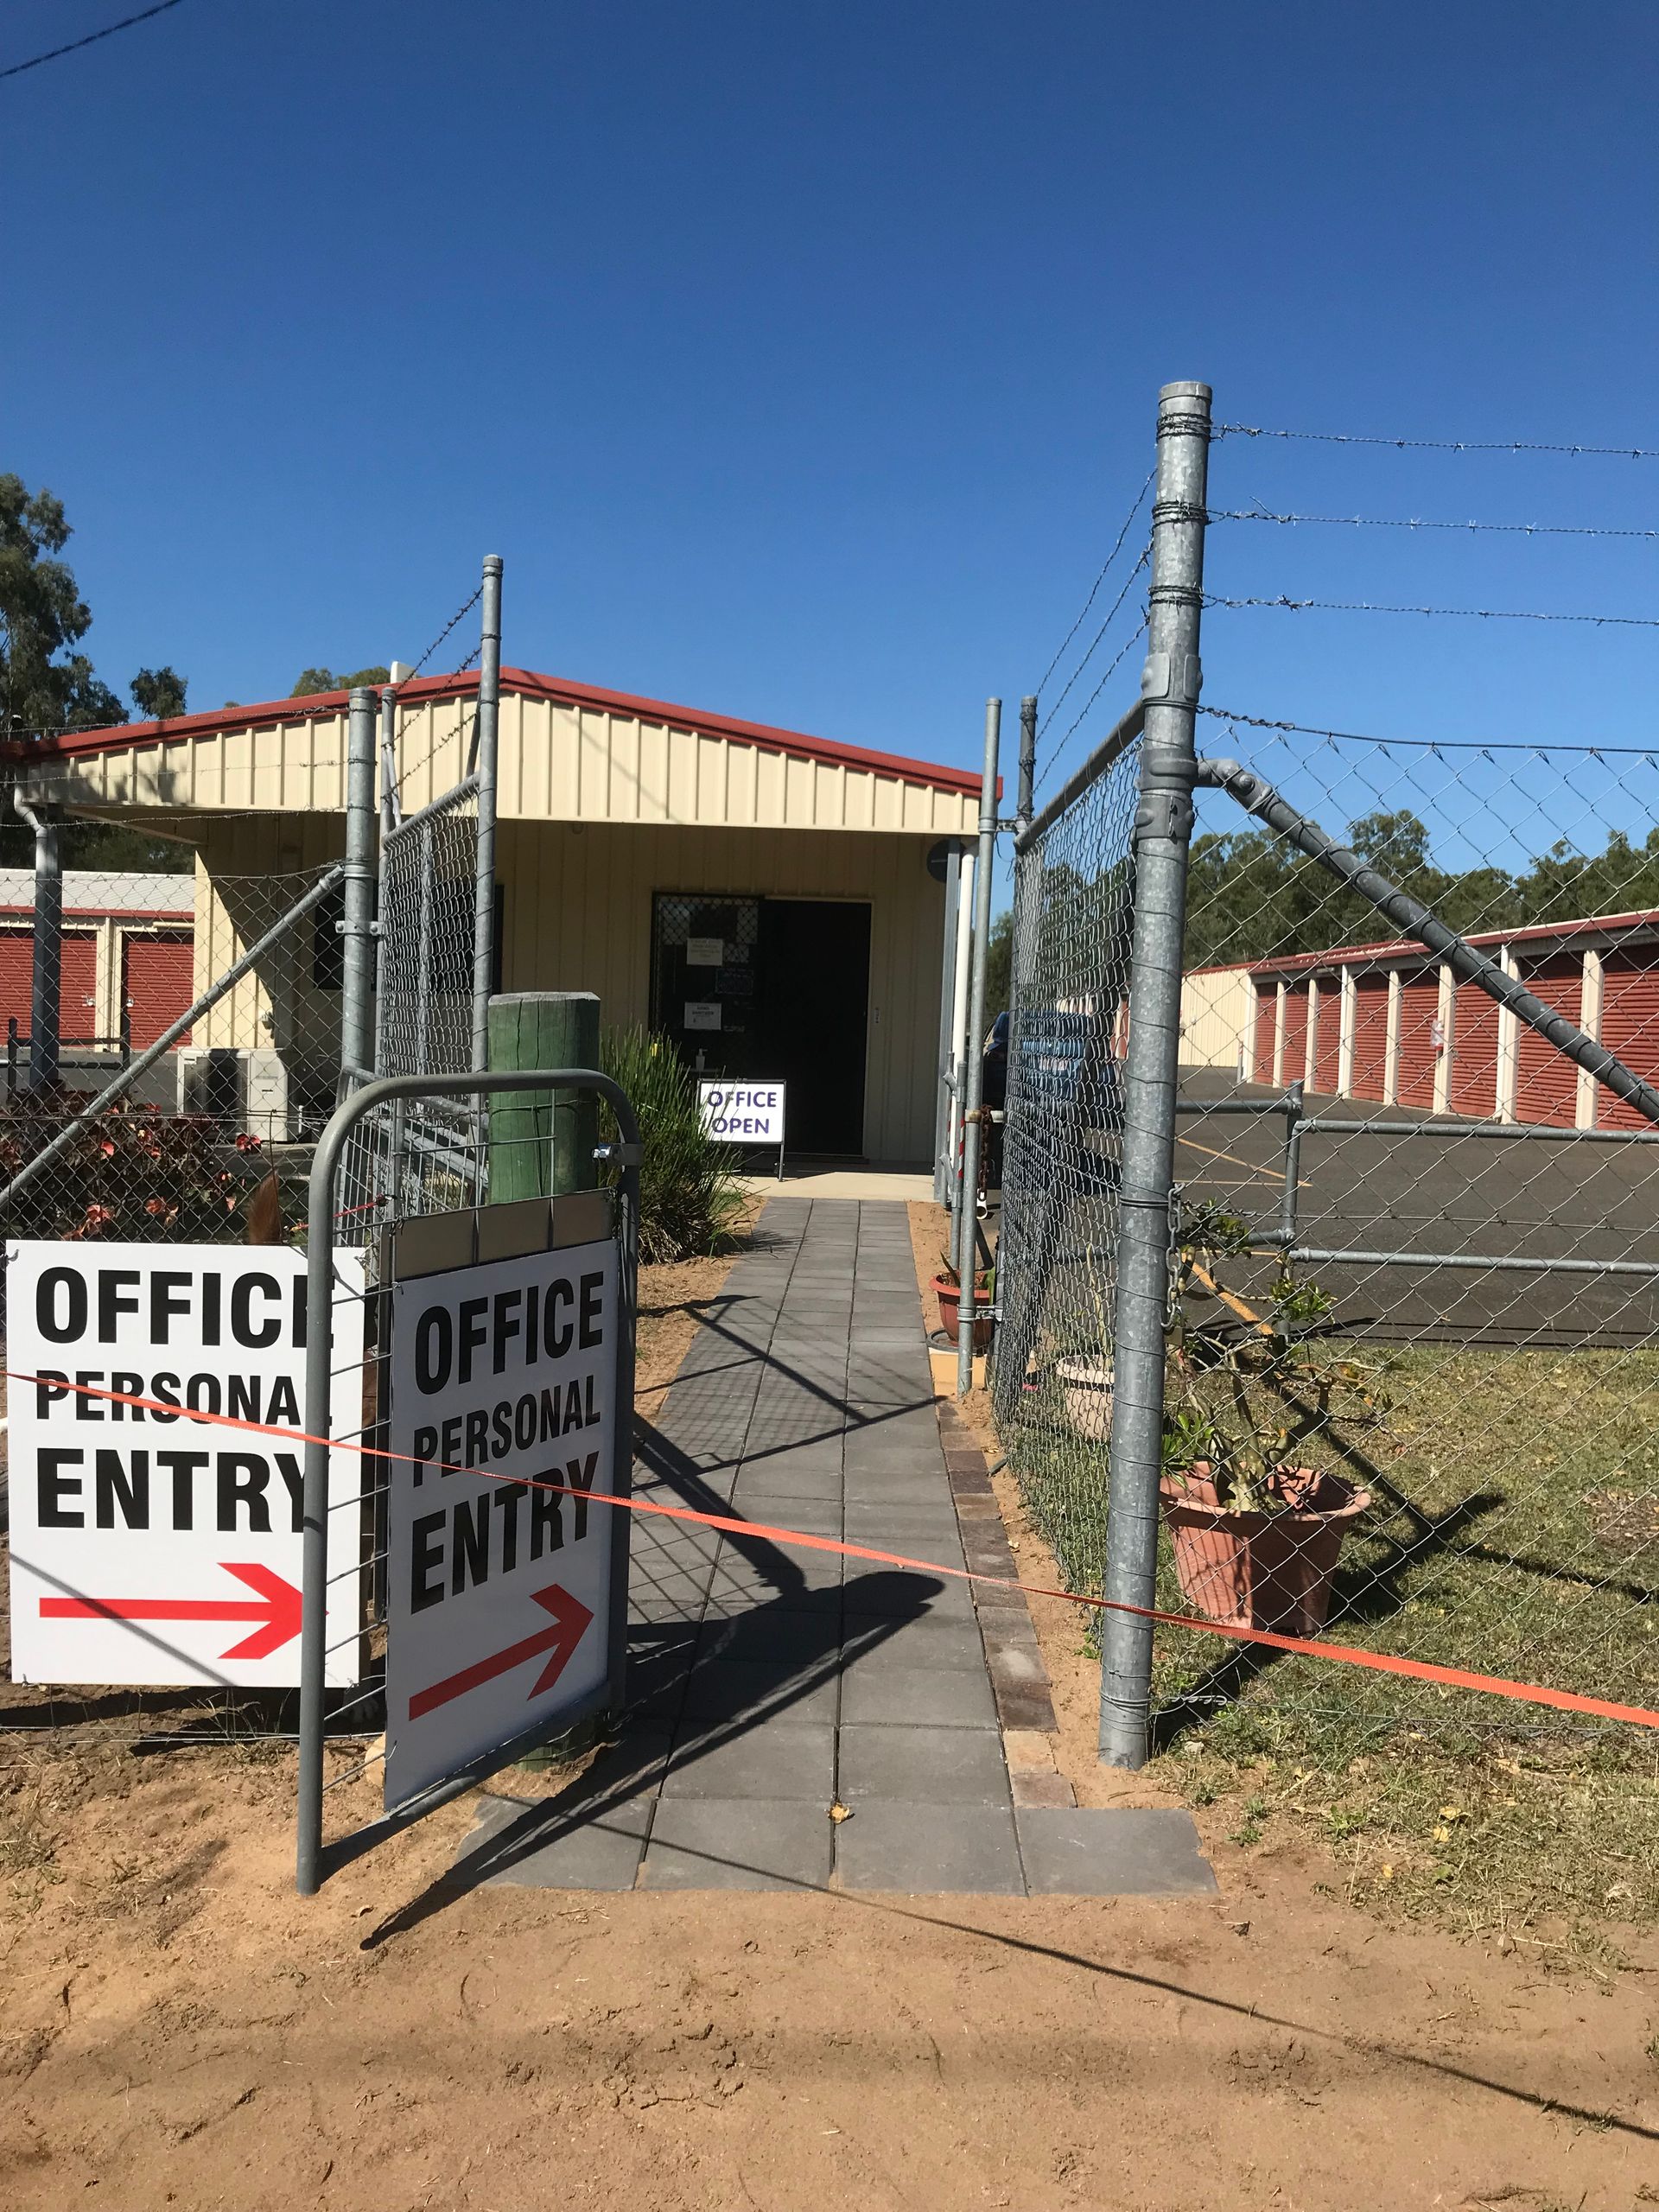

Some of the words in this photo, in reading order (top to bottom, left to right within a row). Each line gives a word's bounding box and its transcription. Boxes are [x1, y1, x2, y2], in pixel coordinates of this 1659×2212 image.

[708, 1091, 777, 1108] OFFICE
[712, 1117, 770, 1135] OPEN
[415, 1270, 605, 1395] OFFICE
[35, 1370, 333, 1427] PERSONA
[412, 1375, 601, 1489] PERSONAL
[410, 1450, 600, 1616] ENTRY
